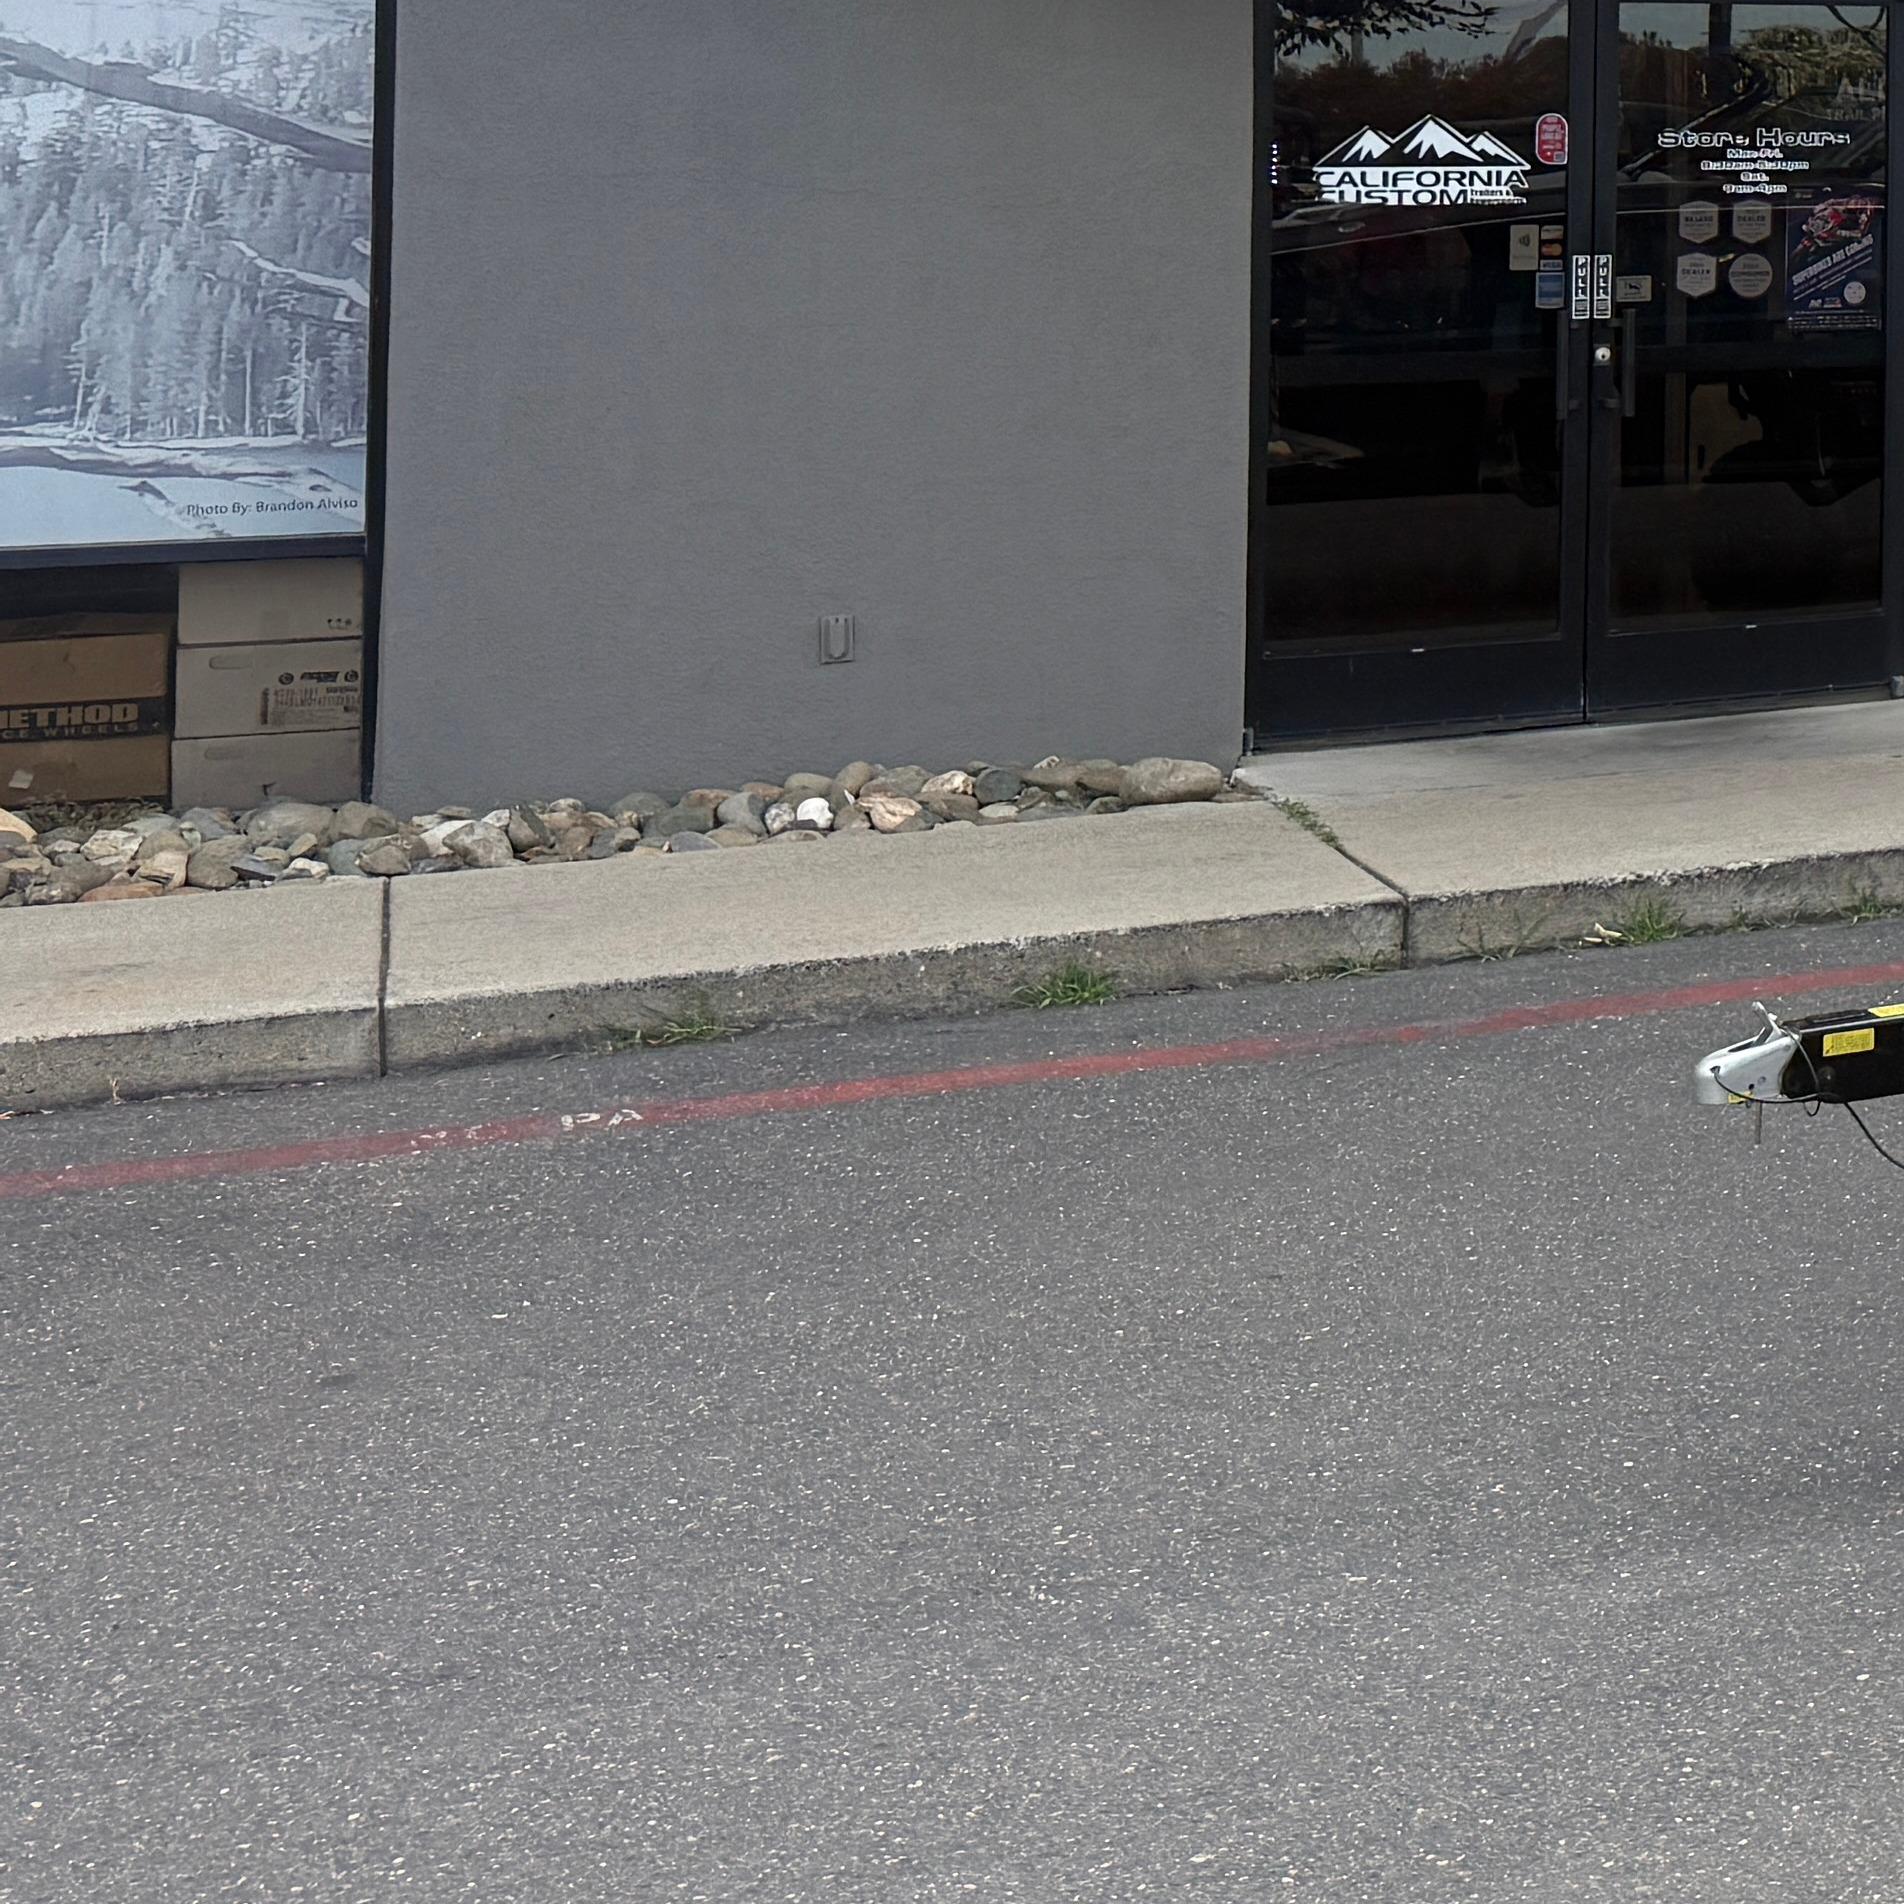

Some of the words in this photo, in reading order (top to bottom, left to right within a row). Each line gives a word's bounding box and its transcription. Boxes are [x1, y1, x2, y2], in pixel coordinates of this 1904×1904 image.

[1658, 127, 1750, 148] Store
[1756, 127, 1851, 148] Hours
[1314, 169, 1529, 188] CALIFORNIA
[255, 498, 314, 514] Brandon
